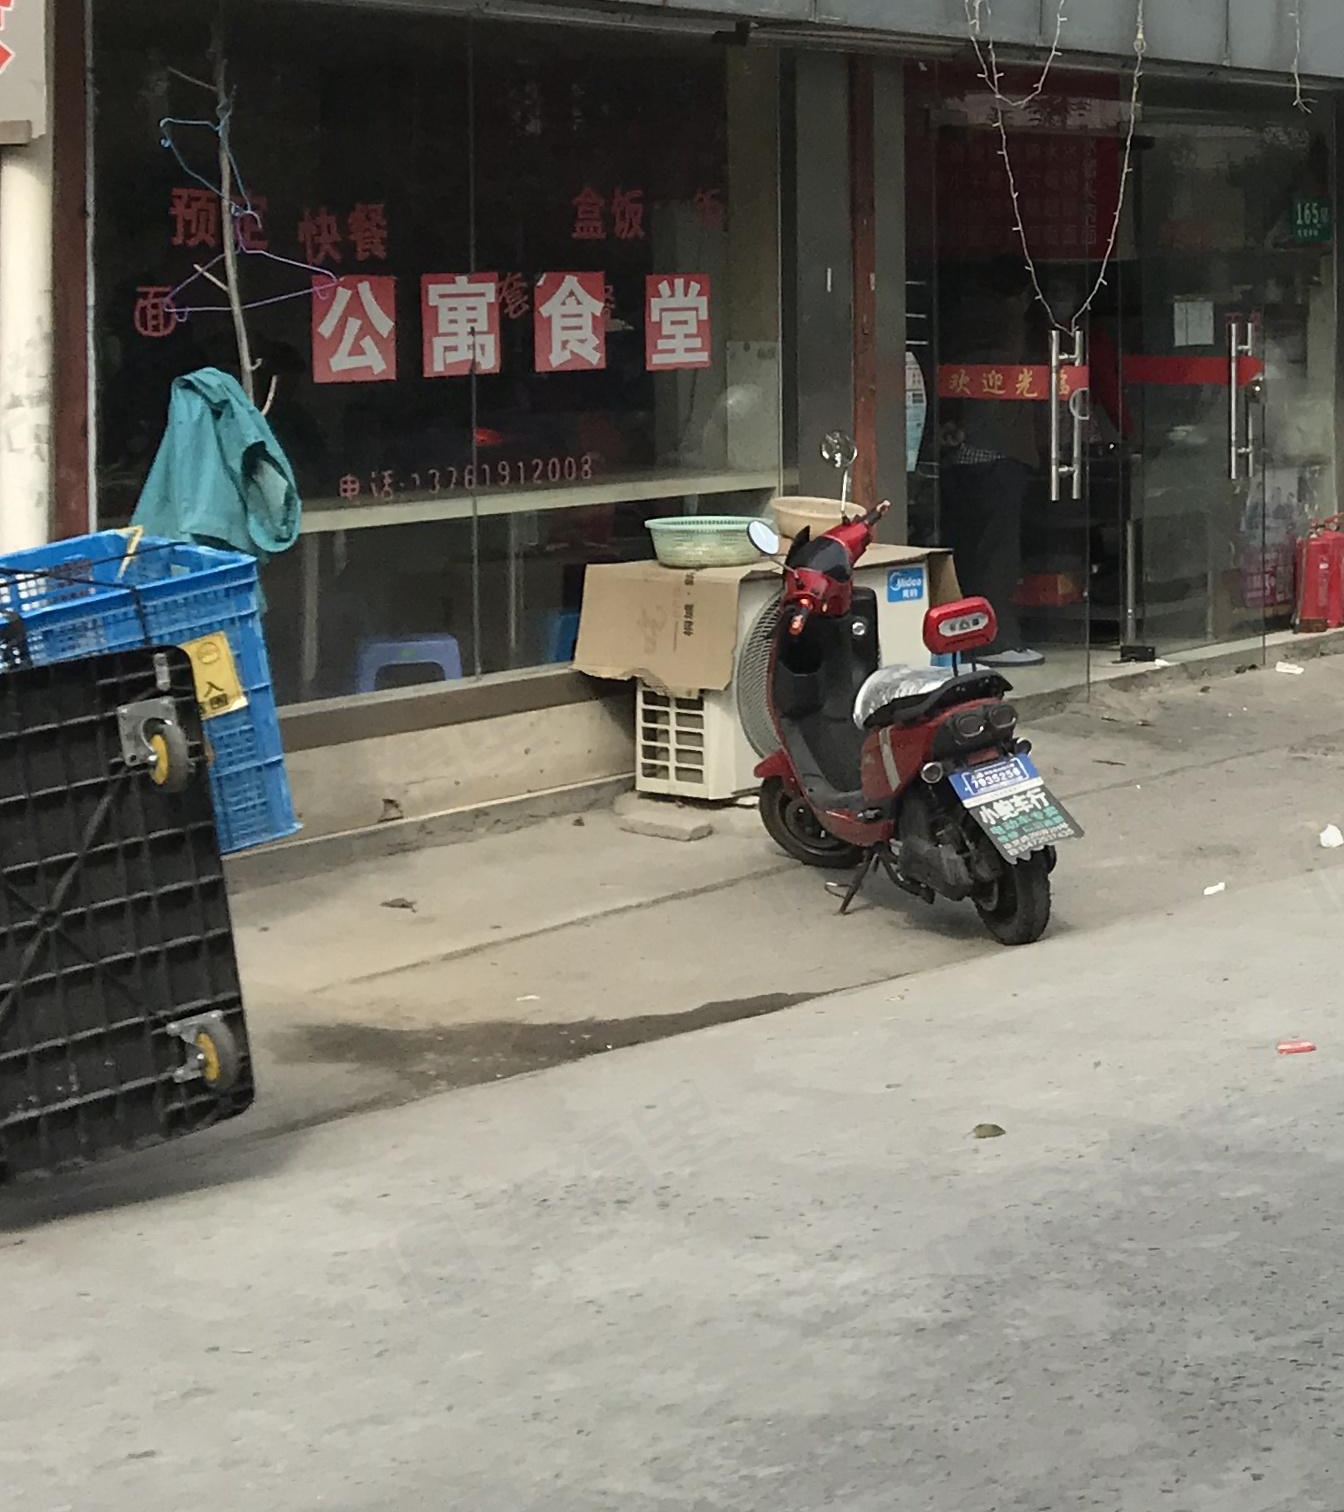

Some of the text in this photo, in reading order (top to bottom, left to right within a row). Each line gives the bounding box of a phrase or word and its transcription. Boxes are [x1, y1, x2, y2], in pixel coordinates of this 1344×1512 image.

[298, 203, 388, 264] 快餐
[571, 185, 645, 240] 盒饭
[316, 276, 709, 376] 公寓食堂
